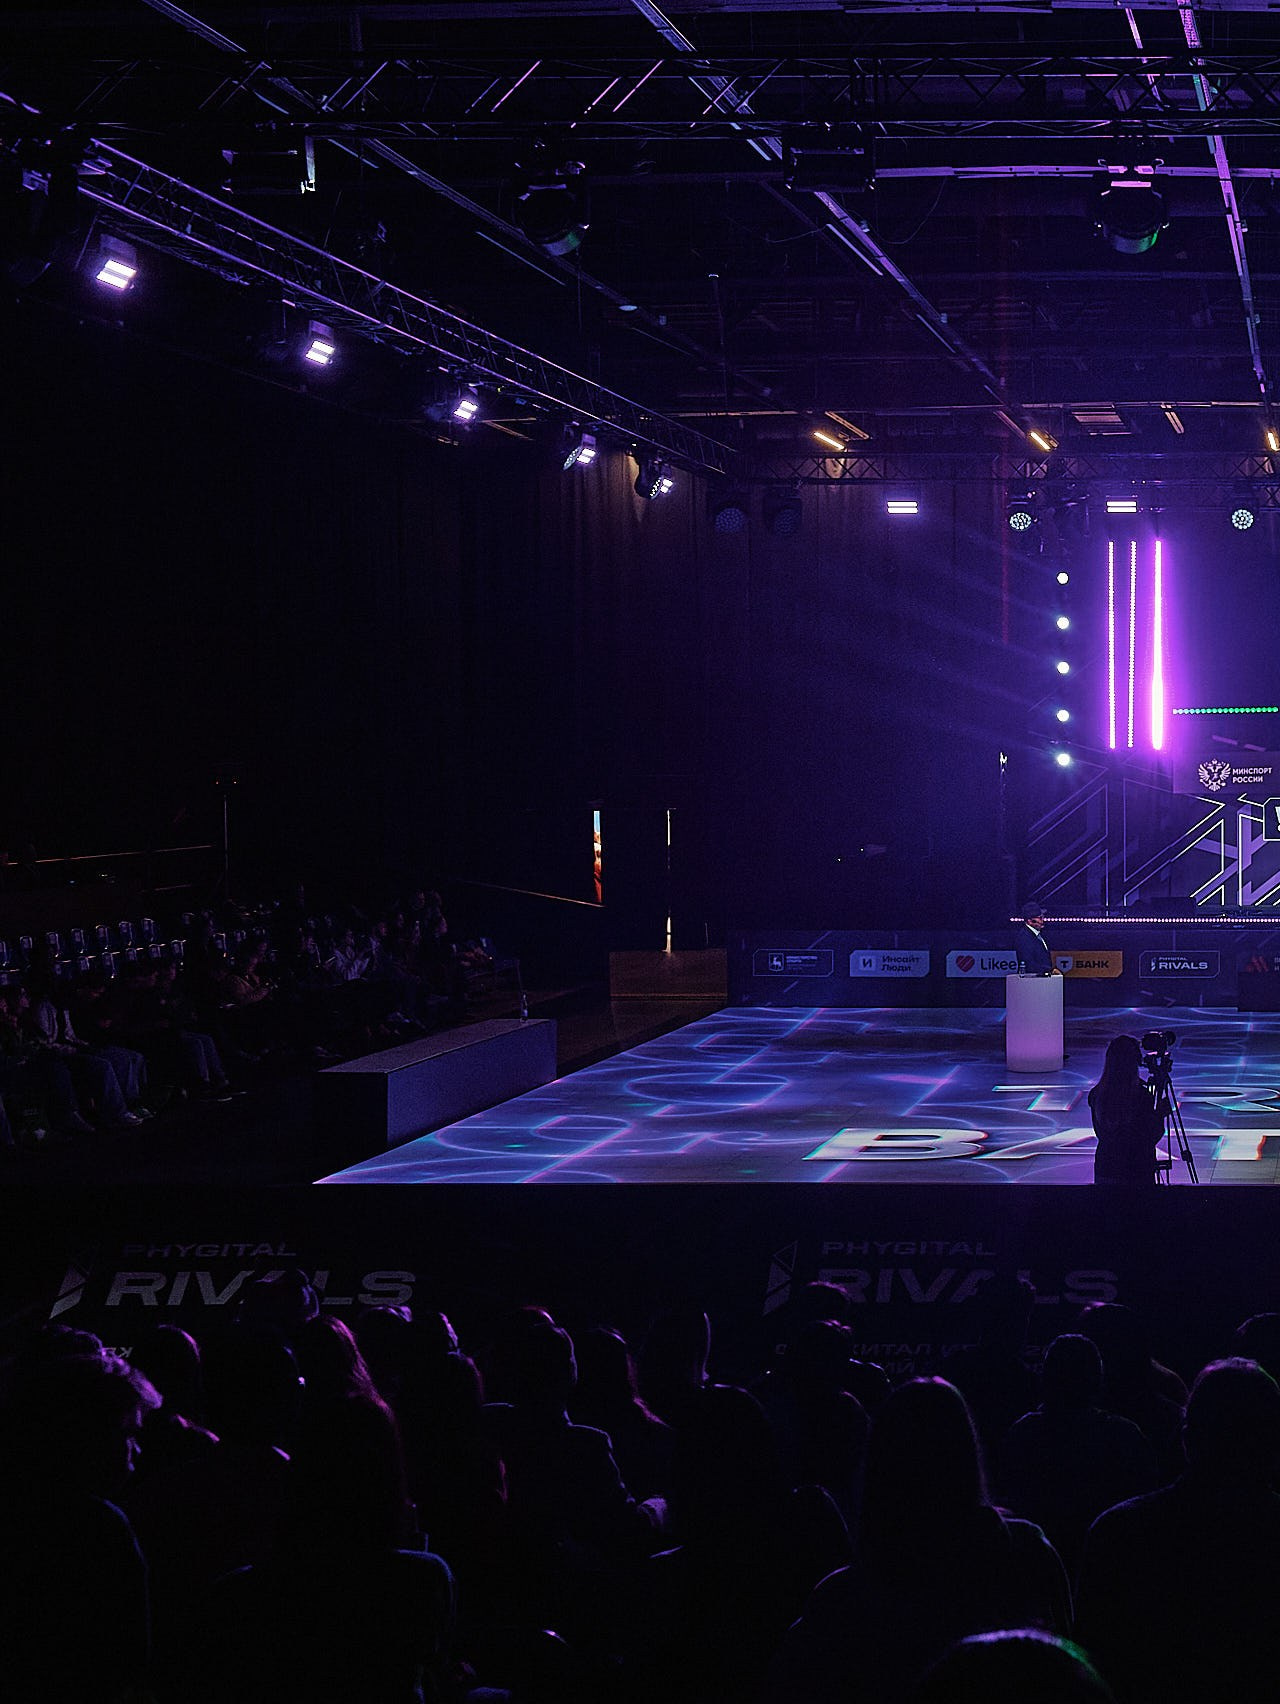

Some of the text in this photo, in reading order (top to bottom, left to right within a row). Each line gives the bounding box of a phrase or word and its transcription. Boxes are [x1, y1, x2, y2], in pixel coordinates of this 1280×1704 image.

[1232, 767, 1273, 776] МИНСПОРТ
[1232, 776, 1264, 784] РОССИИ
[980, 958, 1018, 971] Likee
[1076, 960, 1109, 969] БАНК
[1160, 962, 1209, 970] RIVALS
